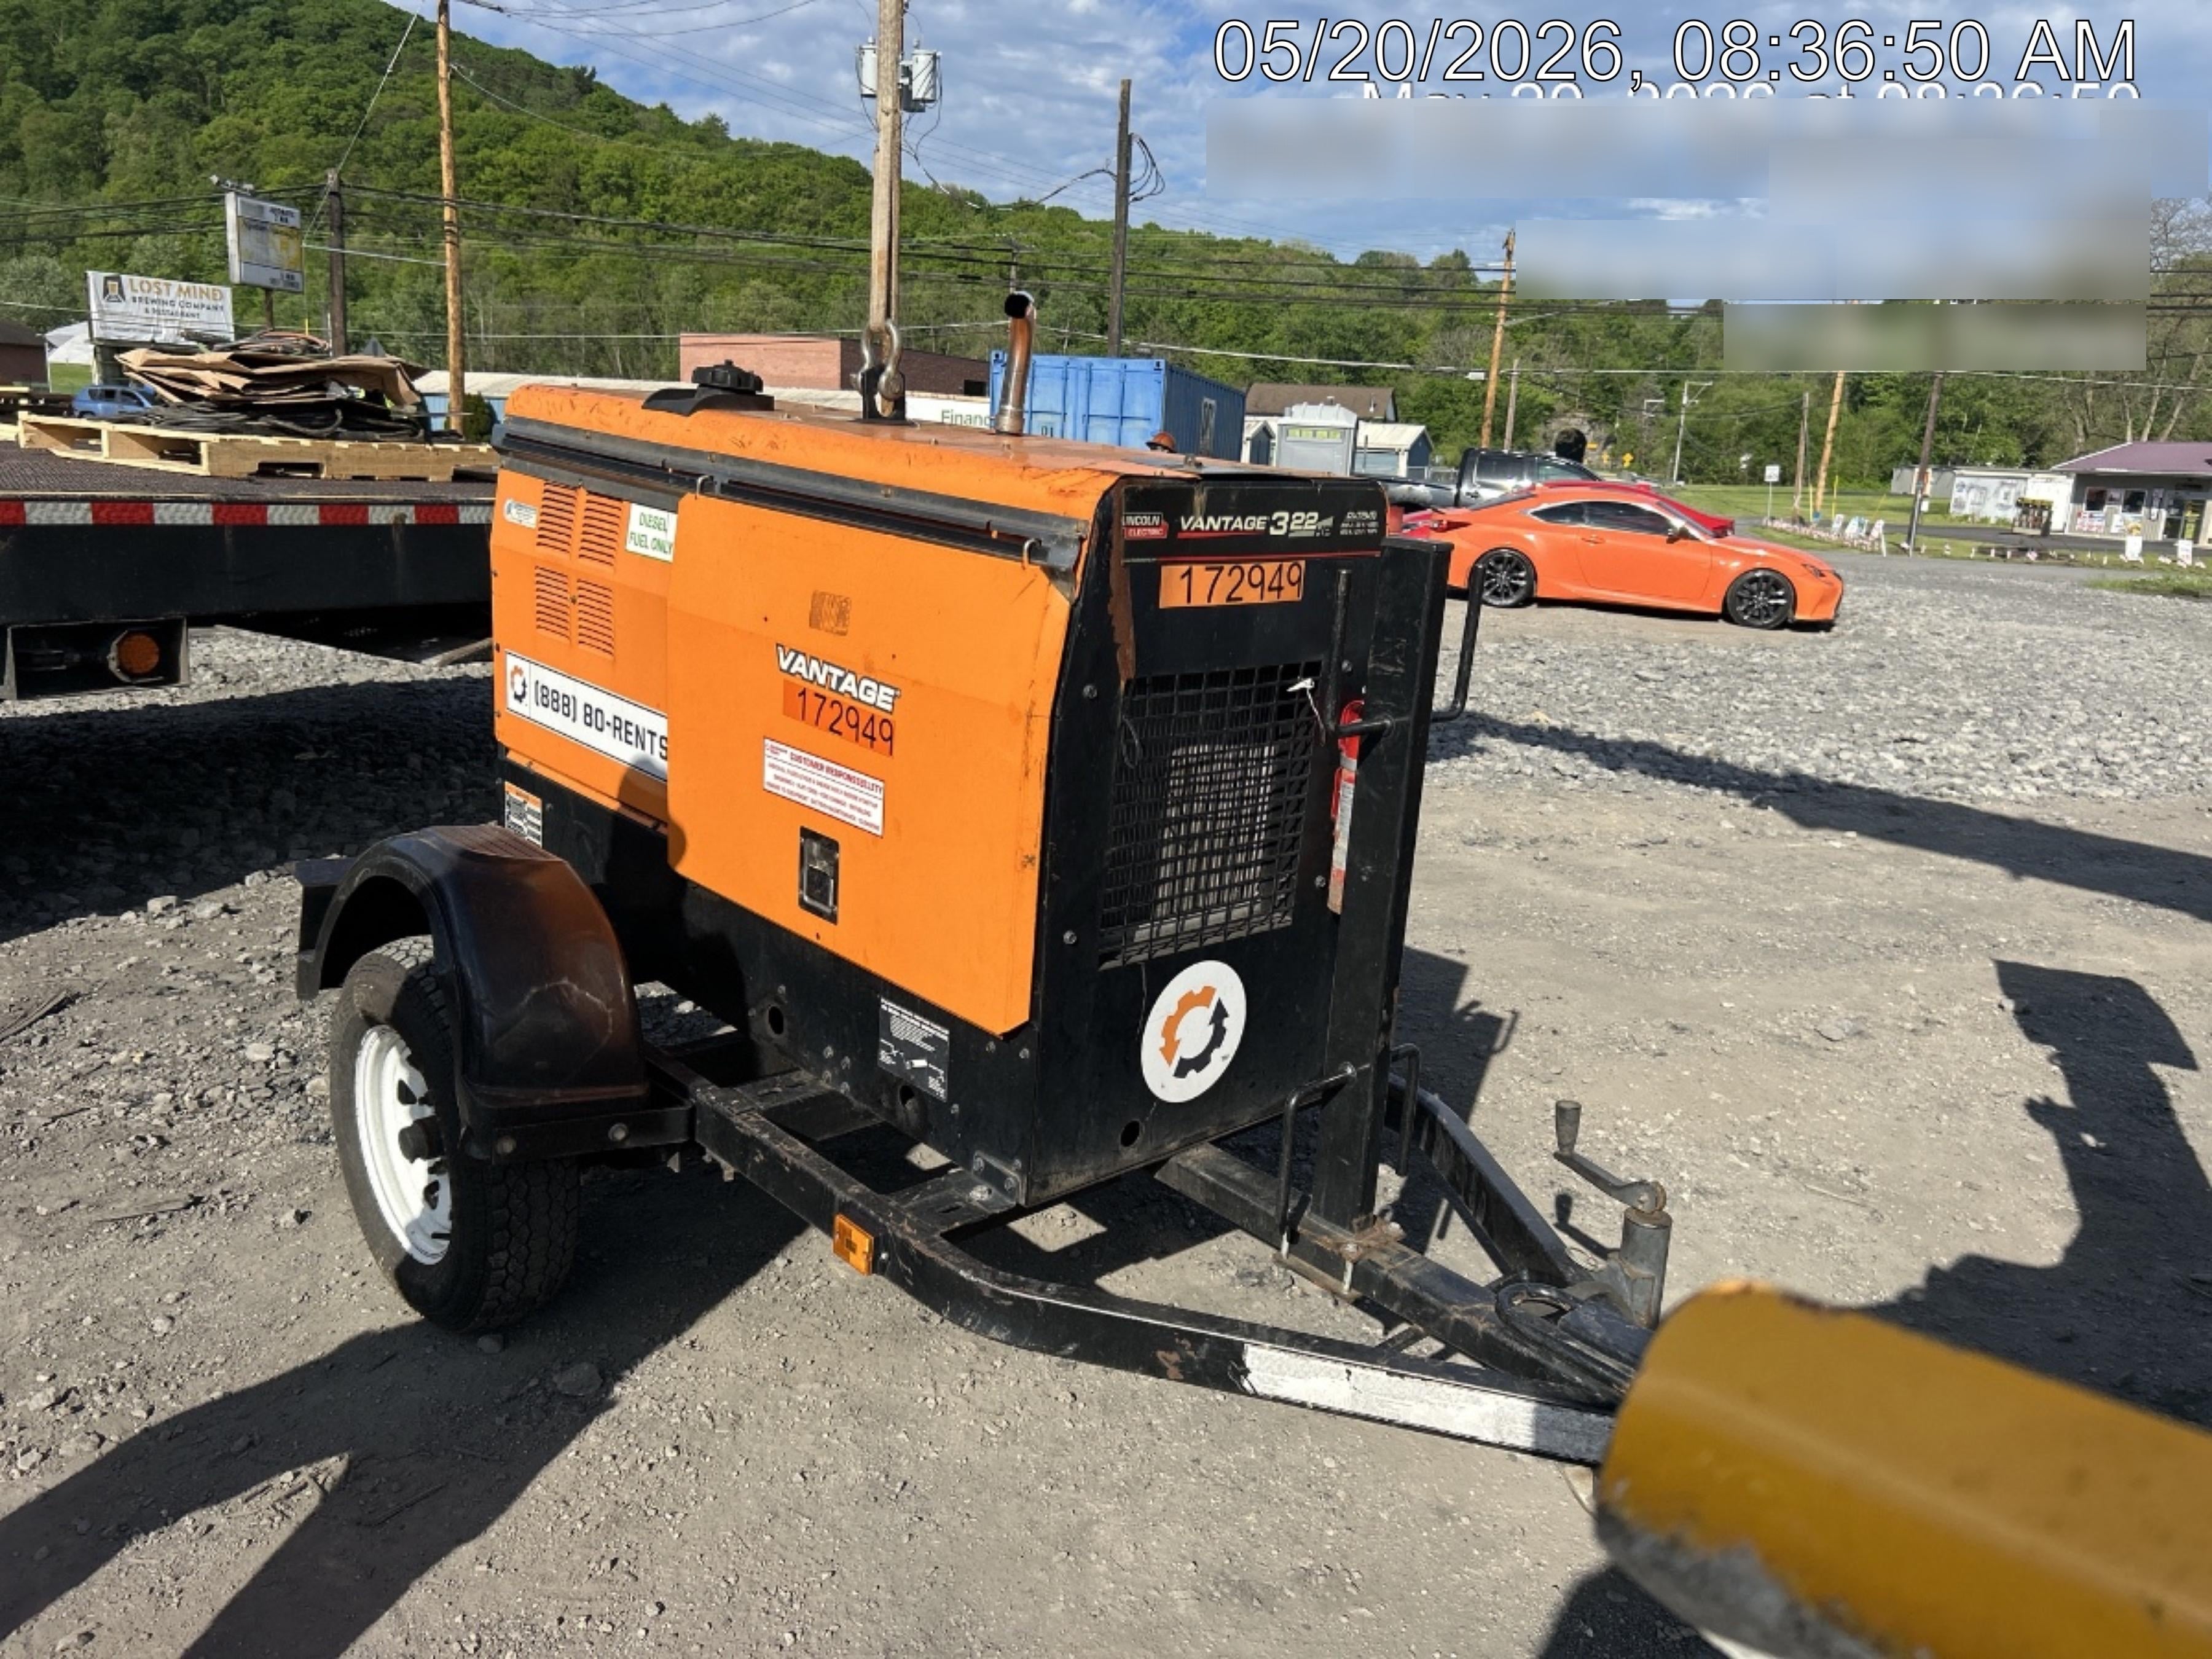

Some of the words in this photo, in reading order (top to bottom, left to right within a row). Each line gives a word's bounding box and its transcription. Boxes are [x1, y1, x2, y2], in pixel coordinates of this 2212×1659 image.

[129, 278, 173, 296] LOST
[176, 281, 224, 301] MIND
[131, 296, 176, 307] BREWING
[178, 299, 224, 312] COMPANY
[638, 512, 668, 532] DIESEL
[1180, 515, 1268, 531] VANTAGE
[1269, 511, 1319, 536] 322
[629, 532, 649, 550] FUEL
[651, 536, 673, 555] ONLY
[1179, 561, 1303, 604] 172949
[775, 642, 895, 716] VANTAGE
[583, 702, 668, 761] 80-RENTS
[798, 686, 893, 756] 172949
